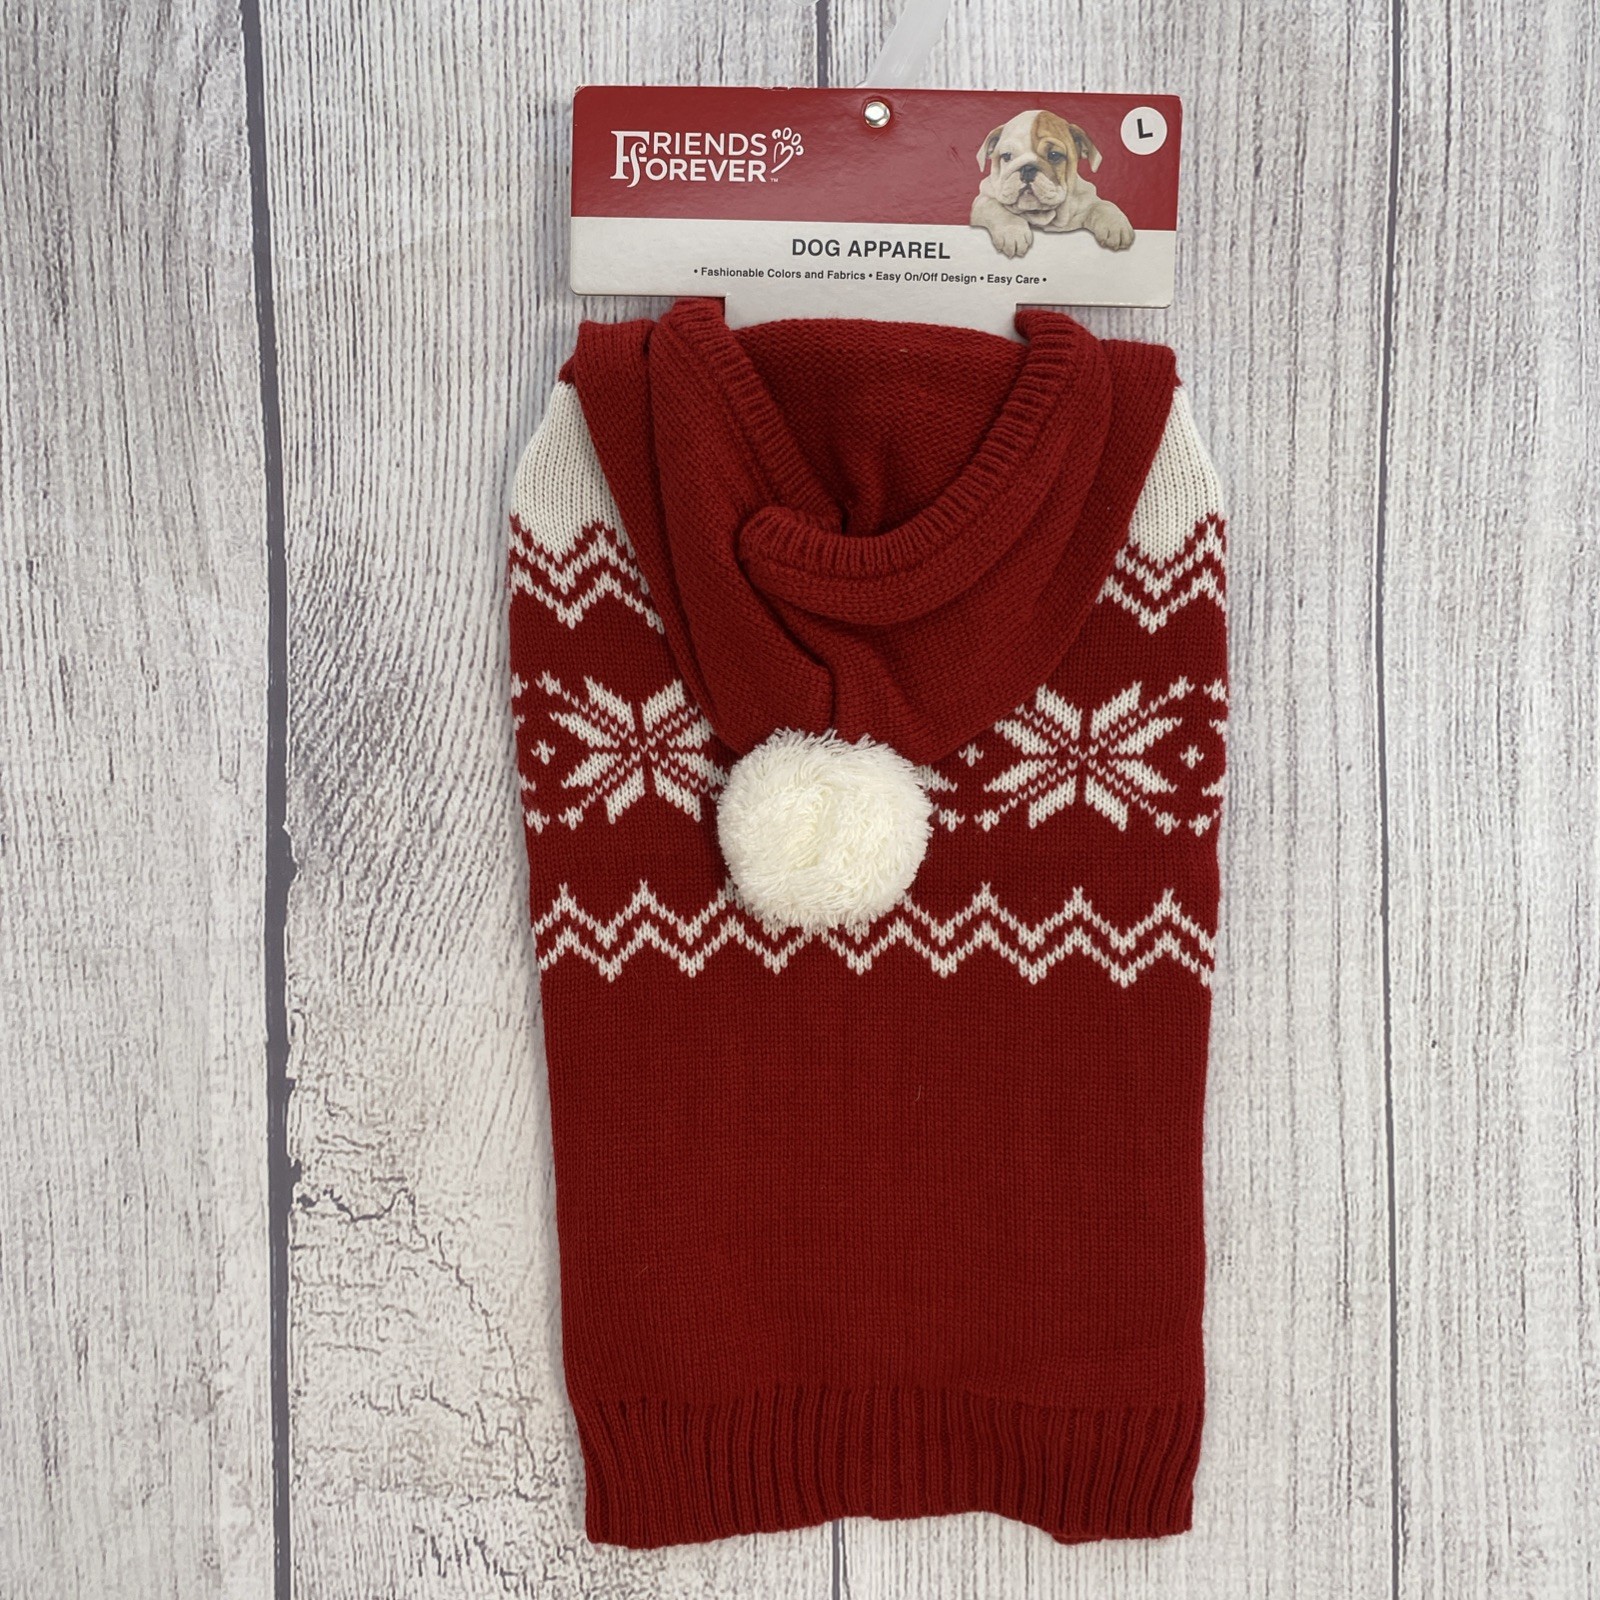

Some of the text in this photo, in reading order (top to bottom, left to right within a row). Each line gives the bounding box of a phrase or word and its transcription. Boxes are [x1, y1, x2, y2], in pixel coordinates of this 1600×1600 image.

[1136, 118, 1154, 139] L
[610, 130, 767, 180] FRIENDS
[626, 141, 767, 188] FOREVER
[791, 238, 951, 260] DOG APPAREL
[700, 266, 1040, 286] Fashionable Colors and Fabrics Easy On/Off Design Easy Care
